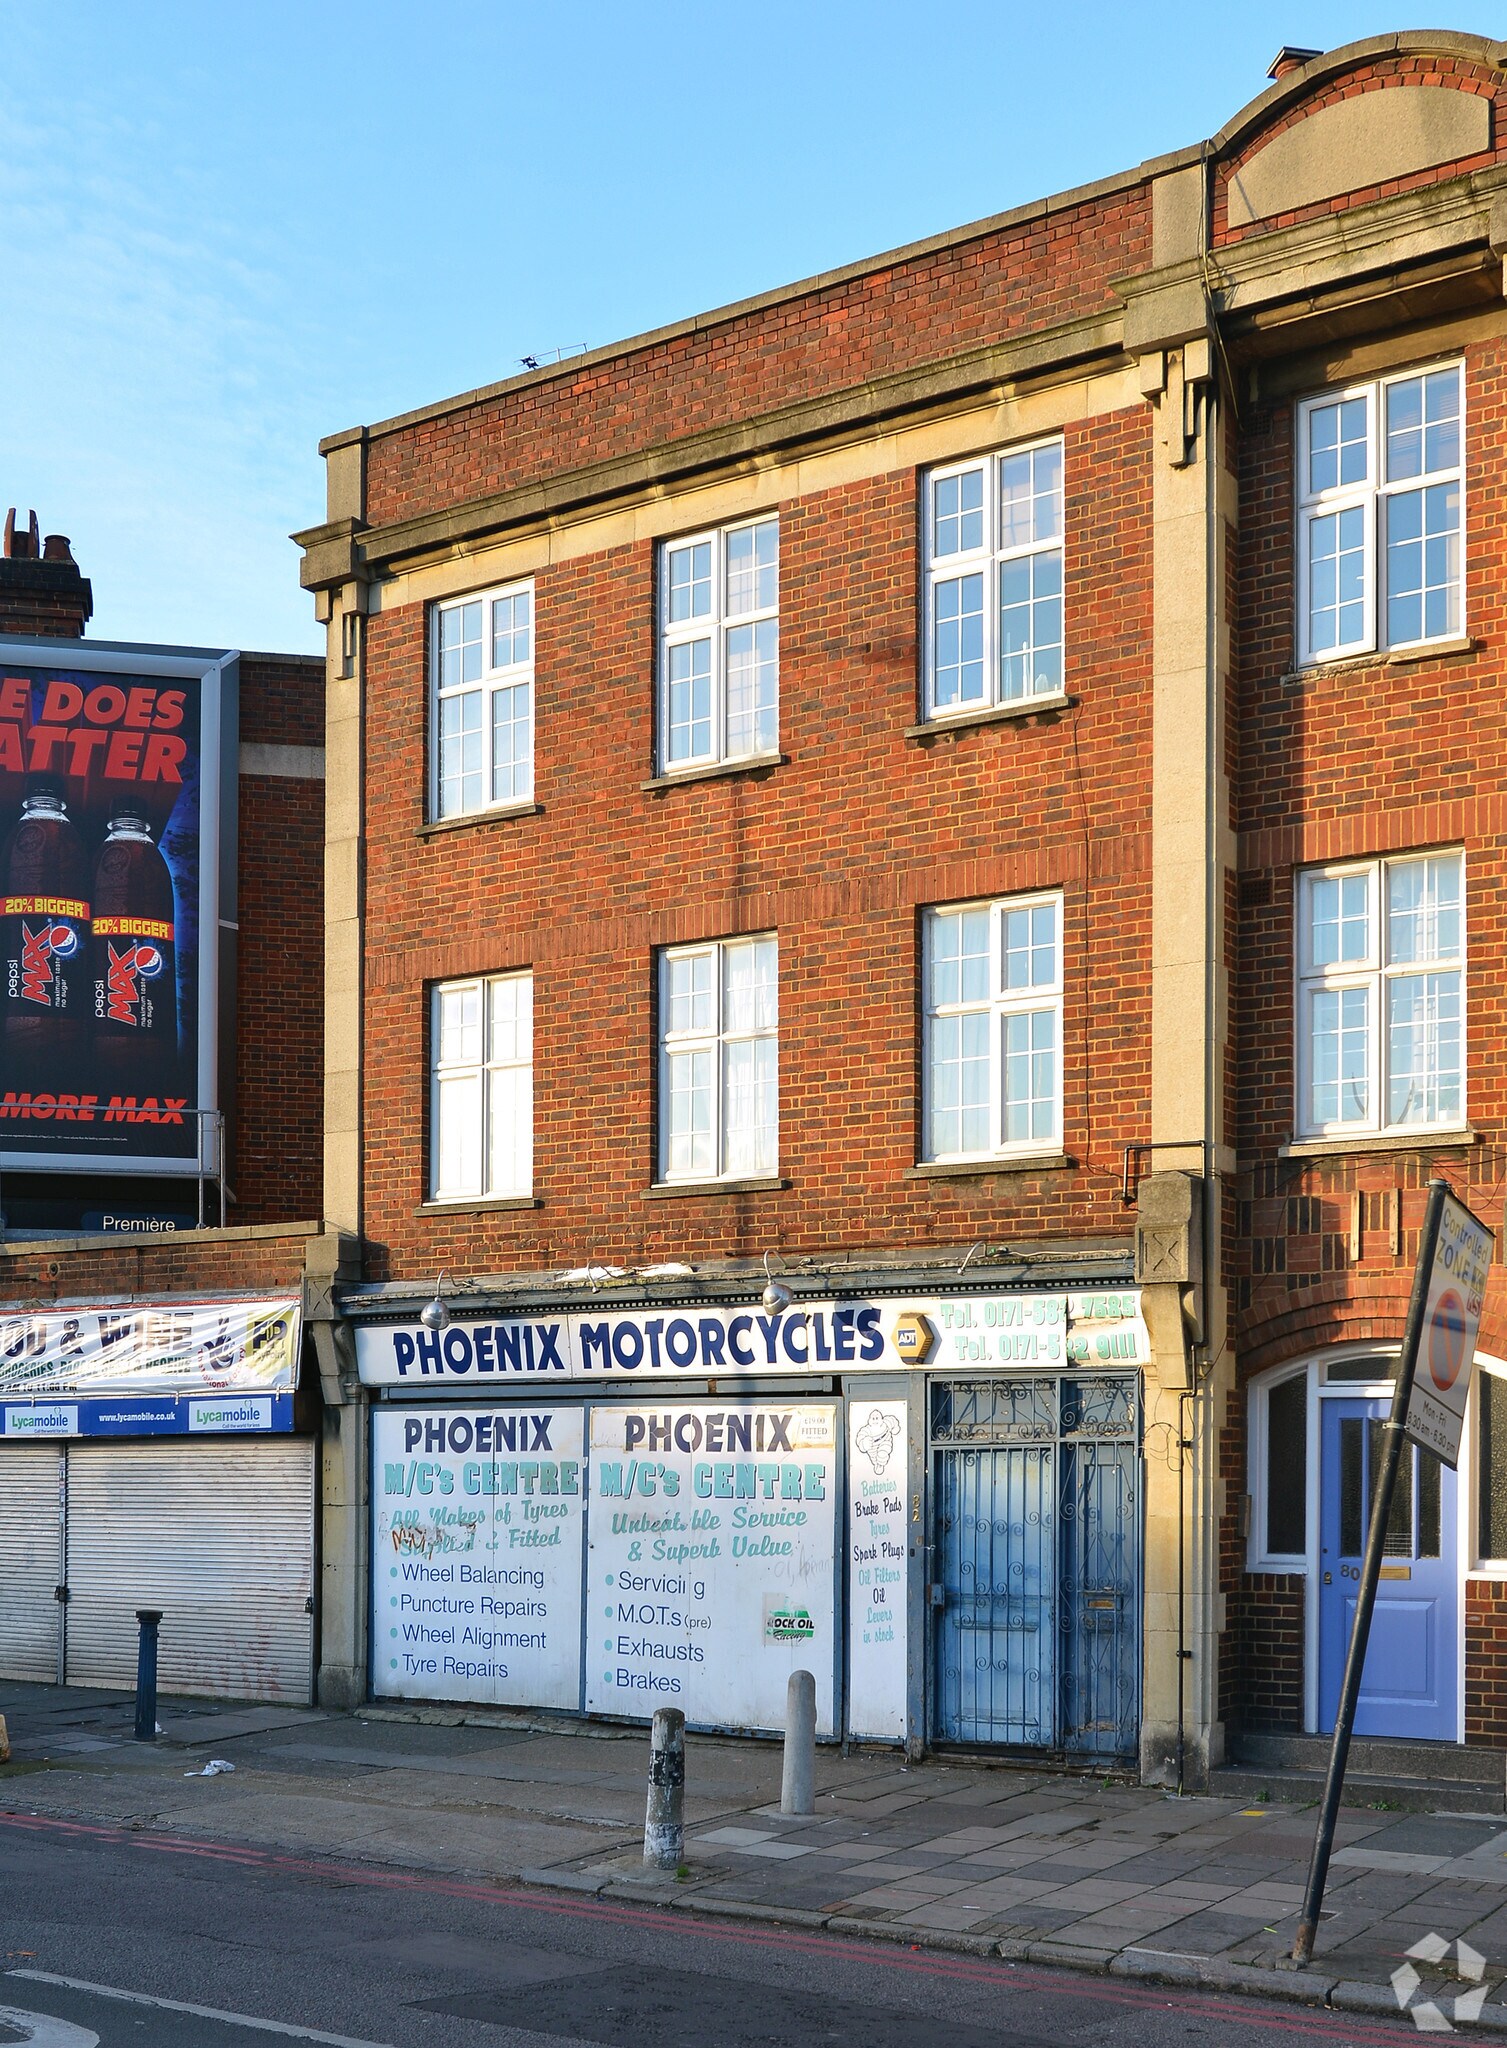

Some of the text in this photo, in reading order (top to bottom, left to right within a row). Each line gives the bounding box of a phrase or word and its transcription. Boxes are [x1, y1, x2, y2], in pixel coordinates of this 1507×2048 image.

[0, 678, 187, 729] E DOES
[0, 722, 187, 784] ATTER
[5, 898, 32, 913] 20%
[92, 919, 118, 934] 20%
[21, 919, 54, 1007] MAX
[7, 959, 20, 998] pepsi
[107, 940, 140, 1026] MAX
[93, 980, 106, 1018] pepsi
[0, 1092, 187, 1124] MORE MAX
[103, 1215, 175, 1232] Première
[1443, 1207, 1489, 1265] Controlled
[1436, 1236, 1471, 1287] ZONE
[940, 1303, 977, 1328] Tel.
[1081, 1295, 1136, 1319] 7585
[60, 1319, 85, 1355] &
[393, 1307, 885, 1376] PHOENIX MOTORCYCLES
[898, 1332, 916, 1346] ADT
[954, 1335, 992, 1361] Tel.
[1096, 1332, 1137, 1360] 9111
[12, 1414, 68, 1430] Lycamobile
[98, 1411, 176, 1423] www.lycamobile.co.uk
[196, 1407, 260, 1425] Lycamobile
[1422, 1400, 1436, 1420] Mon
[1438, 1412, 1448, 1428] Fri
[404, 1415, 553, 1454] PHOENIX
[624, 1412, 794, 1454] PHOENIX
[801, 1427, 828, 1435] FITTED
[1407, 1411, 1421, 1430] 8.30
[1420, 1423, 1430, 1437] am
[1432, 1429, 1447, 1448] 6.30
[1446, 1441, 1456, 1455] pm
[384, 1459, 579, 1498] M/C's CENTRE
[600, 1459, 826, 1500] M/C's CENTRE
[860, 1479, 898, 1498] Batteries
[389, 1499, 569, 1530] All Makes of Tyres
[732, 1506, 808, 1528] Service
[854, 1496, 902, 1518] Brake Pads
[508, 1526, 562, 1549] Fitted
[868, 1519, 890, 1540] Tyres
[627, 1535, 793, 1565] & Superb Value
[853, 1541, 904, 1565] Spark Plugs
[402, 1563, 544, 1590] Wheel Balancing
[858, 1566, 901, 1586] Oil Filters
[1341, 1564, 1361, 1582] 80
[401, 1594, 547, 1620] Puncture Repairs
[872, 1587, 887, 1605] Oil
[617, 1603, 712, 1630] M.O.T.s (pre)
[797, 1618, 815, 1629] OIL
[866, 1607, 893, 1624] Levers
[402, 1623, 547, 1650] Wheel Alignment
[773, 1629, 807, 1642] Racing
[862, 1624, 895, 1644] in stock
[616, 1635, 705, 1662] Exhausts
[402, 1653, 509, 1680] Tyre Repairs
[616, 1668, 682, 1693] Brakes
